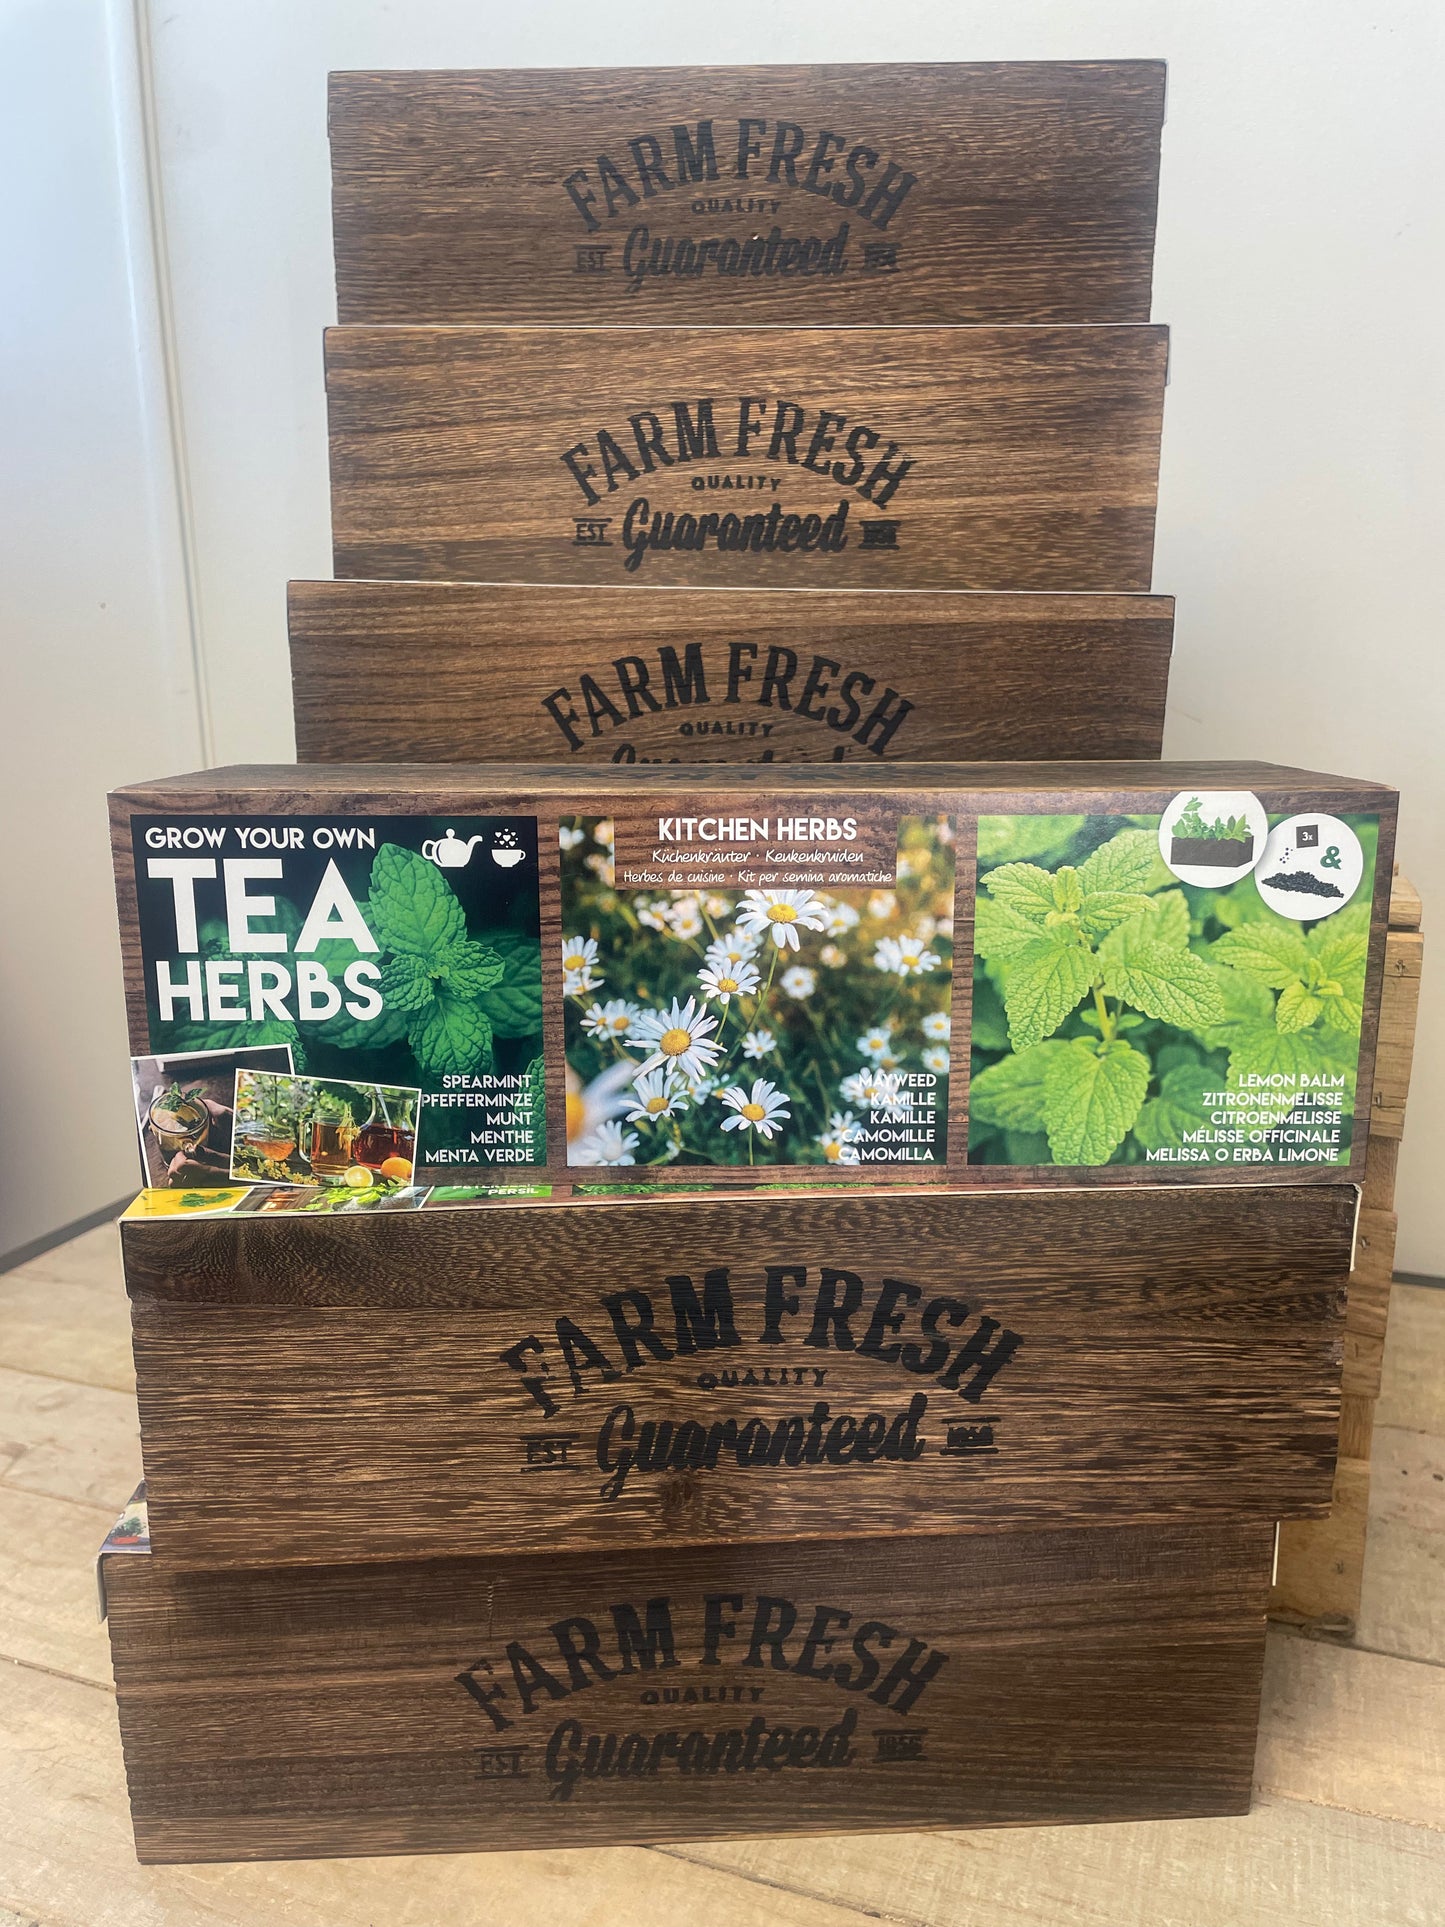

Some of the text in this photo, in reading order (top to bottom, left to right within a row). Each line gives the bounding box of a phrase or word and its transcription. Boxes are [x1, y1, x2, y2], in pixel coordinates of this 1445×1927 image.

[562, 118, 918, 232] FARM FRESH
[691, 198, 781, 214] QUALITY
[622, 222, 850, 294] Guaranteed
[560, 396, 917, 509] FARM FRESH
[691, 475, 782, 492] QUALITY
[576, 523, 607, 539] EST
[622, 497, 849, 572] Guaranteed
[541, 642, 914, 756] FARM FRESH
[679, 720, 774, 737] QUALITY
[658, 817, 858, 841] KITCHEN HERBS
[145, 827, 376, 849] GROW YOUR OWN
[652, 848, 864, 863] Küchenkräuter Keukenkruiden
[623, 870, 893, 886] Herbes de cuisine Kit per semina aromatiche
[147, 857, 381, 954] TEA
[155, 960, 384, 1021] HERBS
[443, 1074, 532, 1089] SPEARMINT
[858, 1074, 937, 1087] MAYWEED
[1238, 1073, 1345, 1088] LEMON BALM
[421, 1094, 533, 1107] PFEFFERMINZE
[870, 1092, 936, 1106] KAMILLE
[1202, 1092, 1343, 1106] ZITRONENMELISSE
[486, 1112, 533, 1126] MUNT
[870, 1111, 935, 1124] KAMILLE
[1210, 1111, 1342, 1125] CITROENMELISSE
[470, 1130, 534, 1144] MENTHE
[841, 1129, 935, 1143] CAMOMILLE
[1183, 1126, 1340, 1143] MÉLISSE OFFICINALE
[425, 1148, 534, 1163] MENTA VERDE
[838, 1147, 934, 1161] CAMOMILLA
[1146, 1148, 1339, 1162] MELISSA O ERBA LIMONE
[501, 1266, 1024, 1418] FARM FRESH
[696, 1367, 829, 1390] QUALITY
[526, 1440, 573, 1464] EST
[596, 1392, 928, 1500] Guaranteed
[454, 1594, 950, 1732] FARM FRESH
[640, 1686, 765, 1705] QUALITY
[480, 1752, 521, 1777] EST
[545, 1707, 858, 1801] Guaranteed
